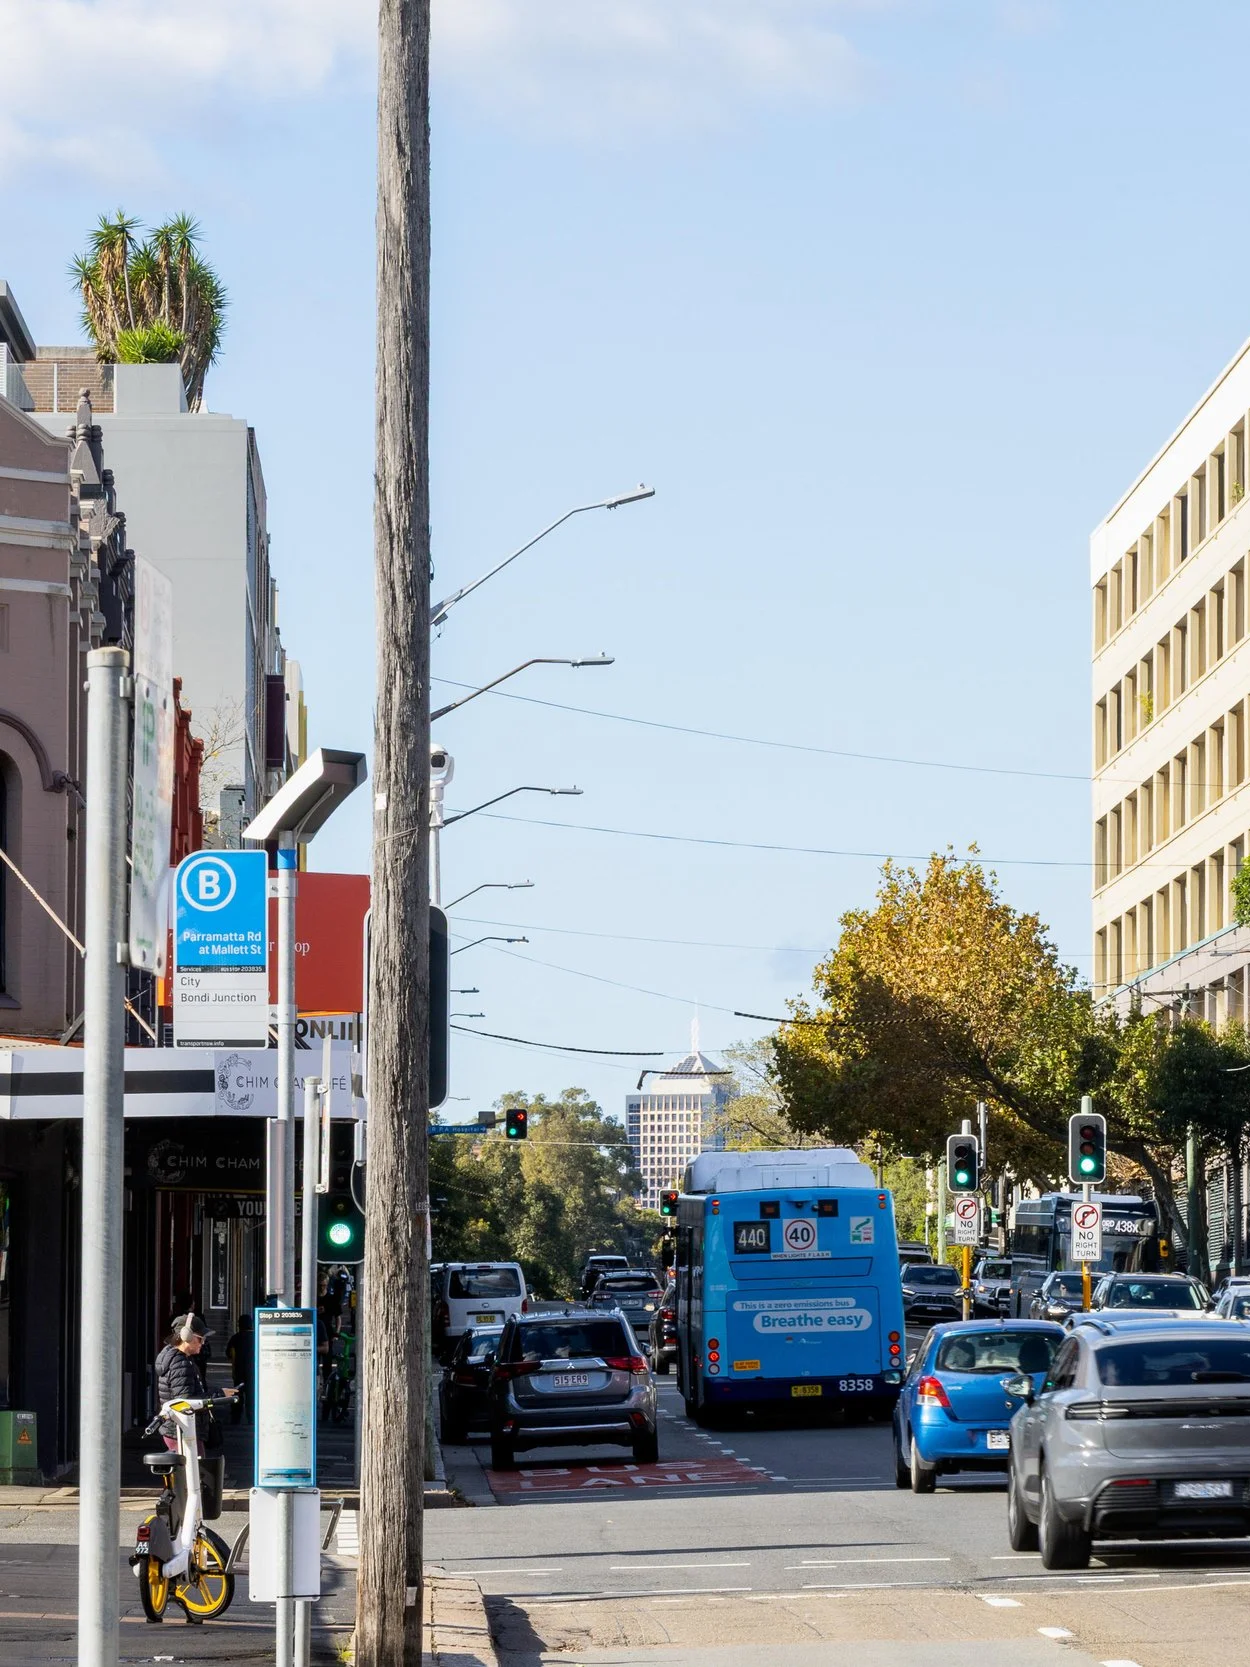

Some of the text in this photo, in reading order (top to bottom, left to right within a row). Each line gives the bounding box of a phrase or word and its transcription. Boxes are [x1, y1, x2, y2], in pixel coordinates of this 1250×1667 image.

[198, 869, 221, 900] B
[183, 931, 262, 942] Parramatta Rd
[198, 945, 210, 955] at
[211, 944, 249, 955] Mallett
[250, 944, 262, 955] St
[180, 977, 201, 988] City
[180, 993, 257, 1002] Bondi Junction
[236, 1075, 269, 1089] CHIM
[167, 1155, 260, 1169] CHIM CHAM
[960, 1220, 973, 1229] NO
[738, 1228, 766, 1247] 440
[789, 1227, 811, 1243] 40
[1078, 1231, 1094, 1240] NO
[740, 1302, 757, 1310] This
[758, 1301, 766, 1309] is
[793, 1300, 834, 1309] emissions
[835, 1299, 850, 1307] bus
[761, 1313, 864, 1328] Breathe easy
[839, 1379, 874, 1392] 8358
[518, 1461, 707, 1478] BUS
[519, 1471, 740, 1489] LANE
